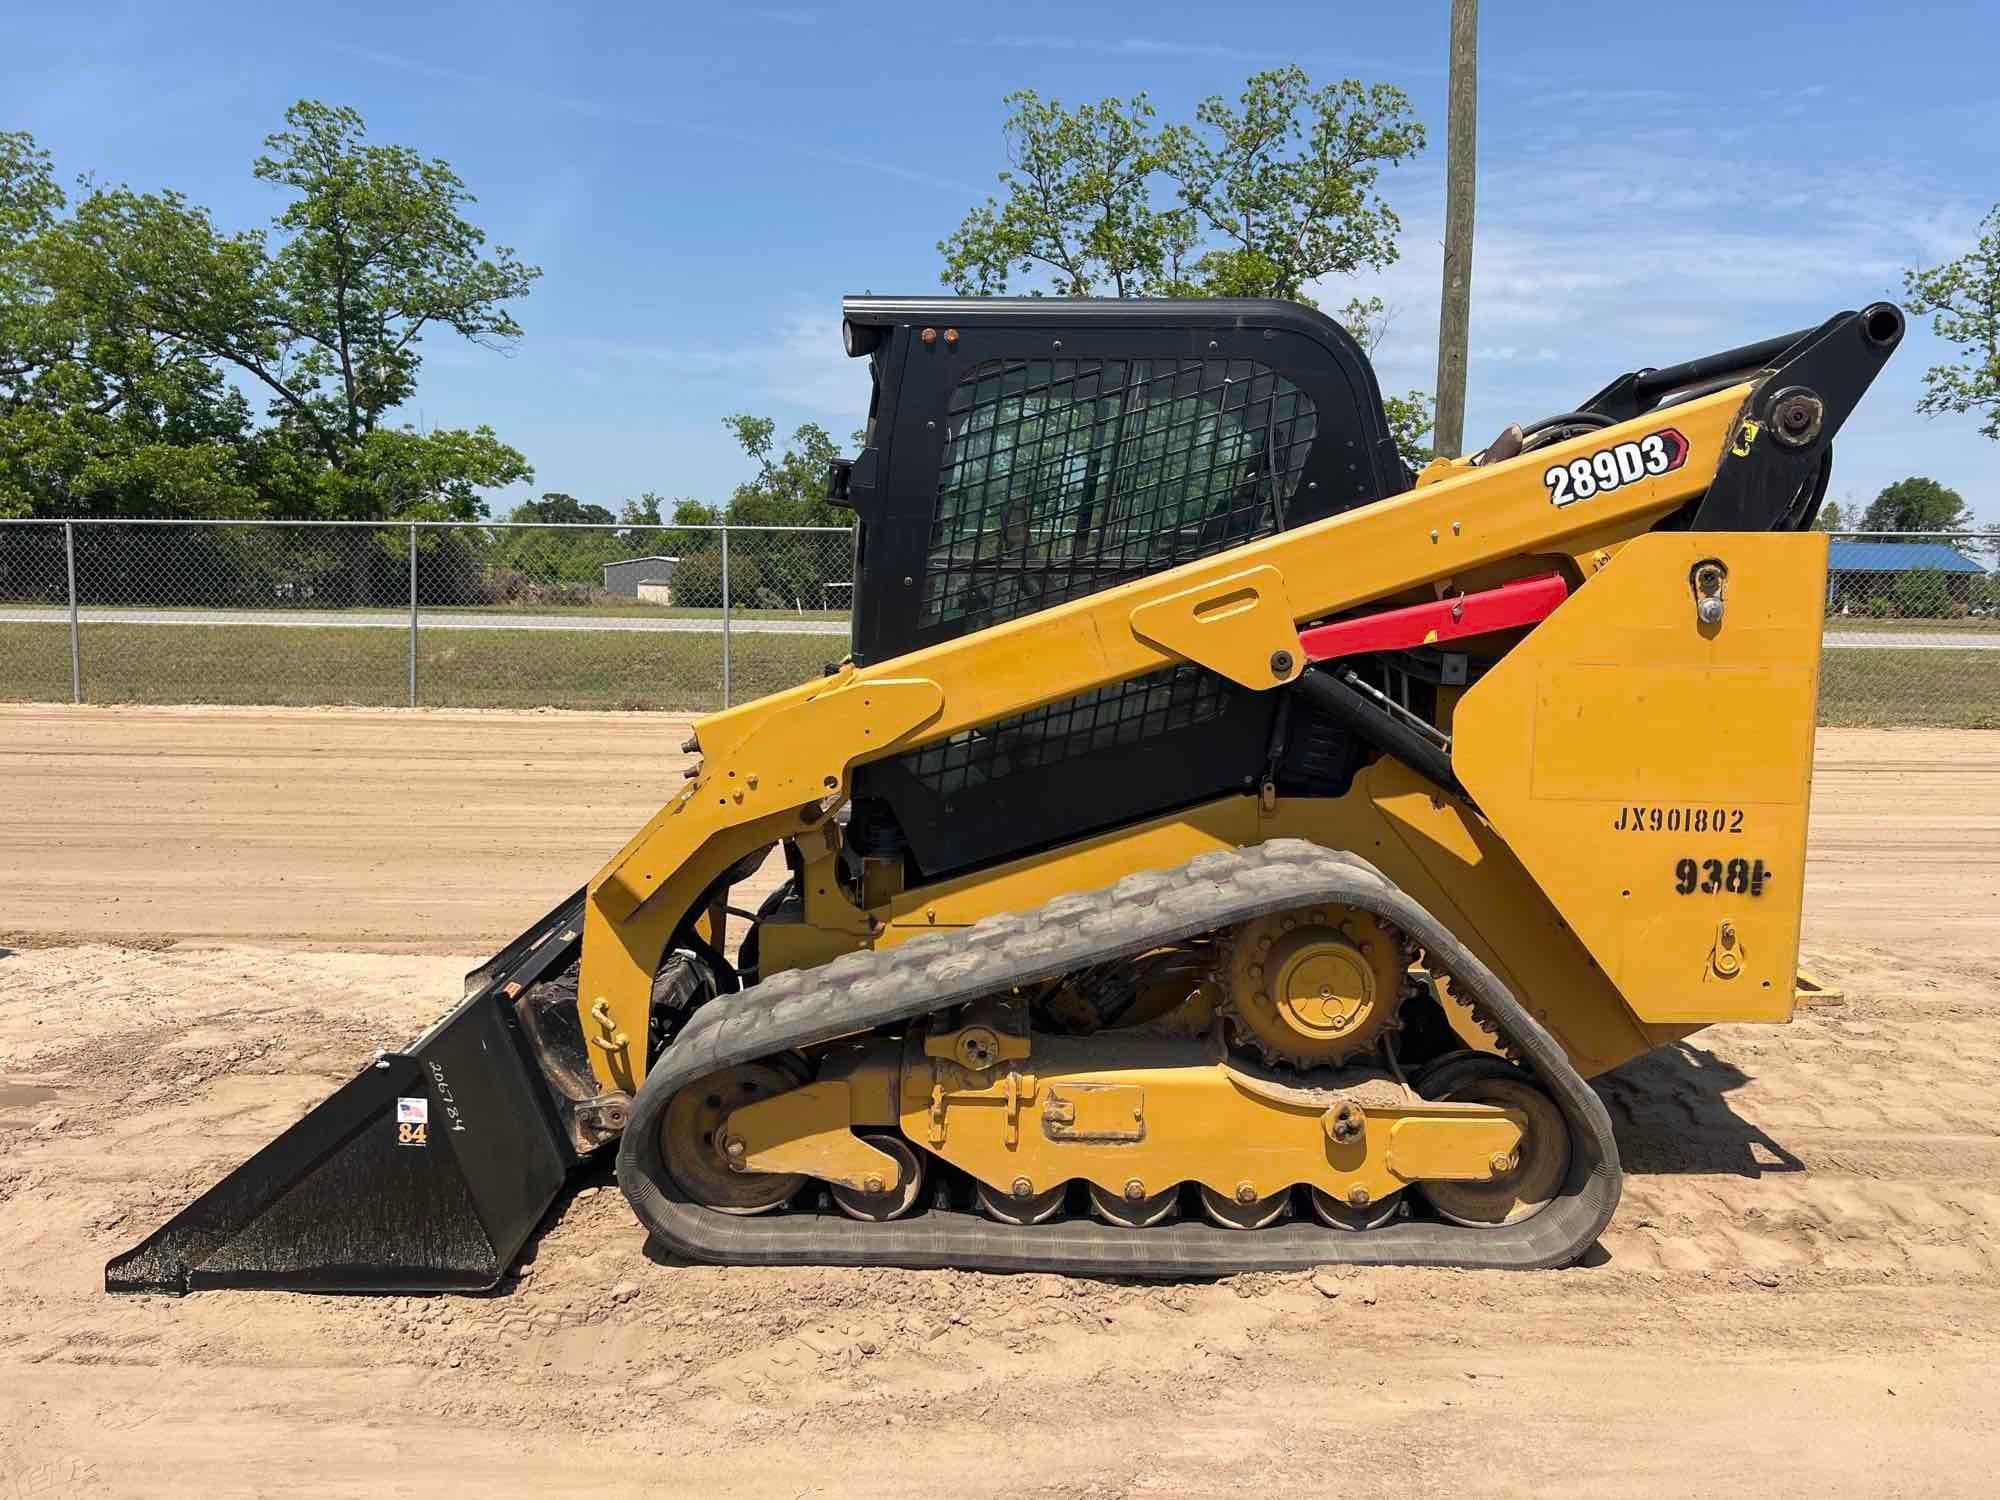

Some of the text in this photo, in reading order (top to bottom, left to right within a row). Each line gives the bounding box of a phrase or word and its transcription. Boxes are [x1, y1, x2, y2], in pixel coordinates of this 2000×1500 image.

[1545, 434, 1669, 507] 289D3
[1614, 807, 1744, 832] JX901802
[398, 1122, 427, 1143] 84
